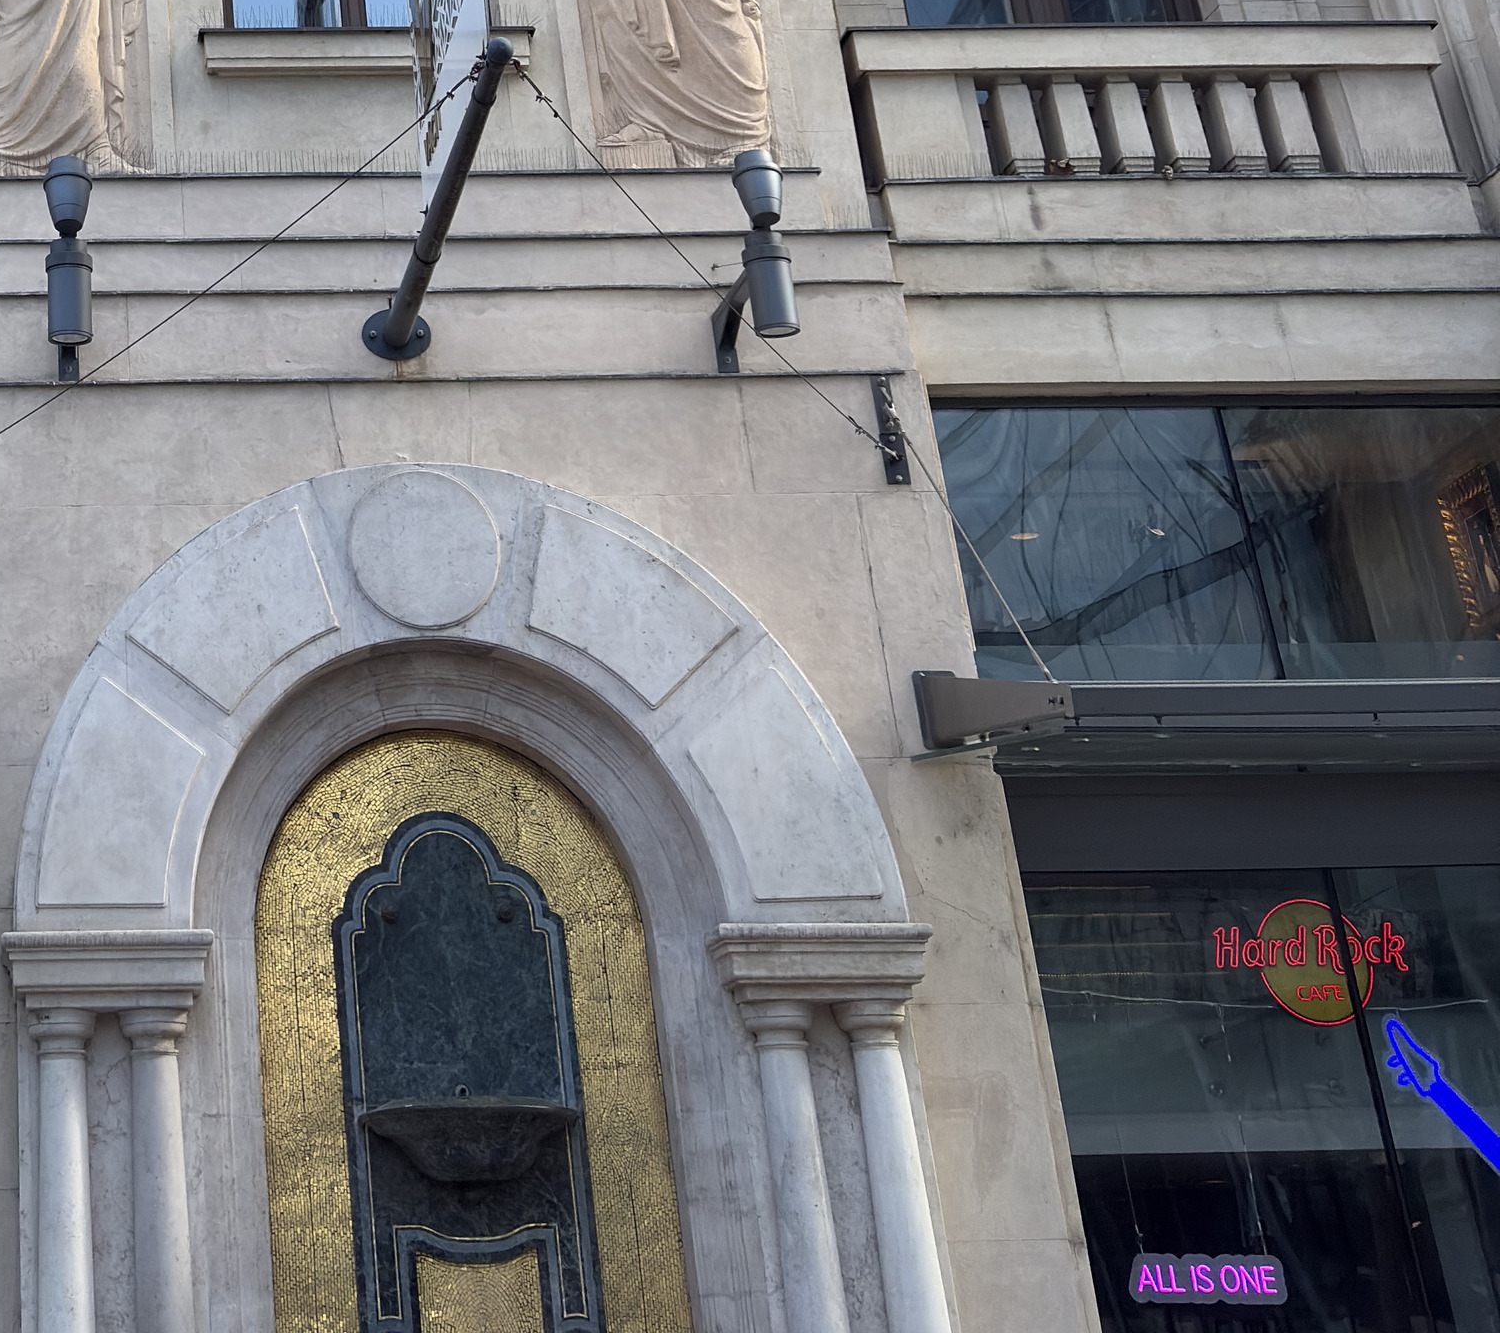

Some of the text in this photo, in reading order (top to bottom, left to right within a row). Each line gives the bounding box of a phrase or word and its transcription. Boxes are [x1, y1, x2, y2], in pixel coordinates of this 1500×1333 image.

[1212, 925, 1306, 969] Hard
[1296, 984, 1345, 1002] CAFE
[1138, 1264, 1278, 1294] ALL IS ONE
